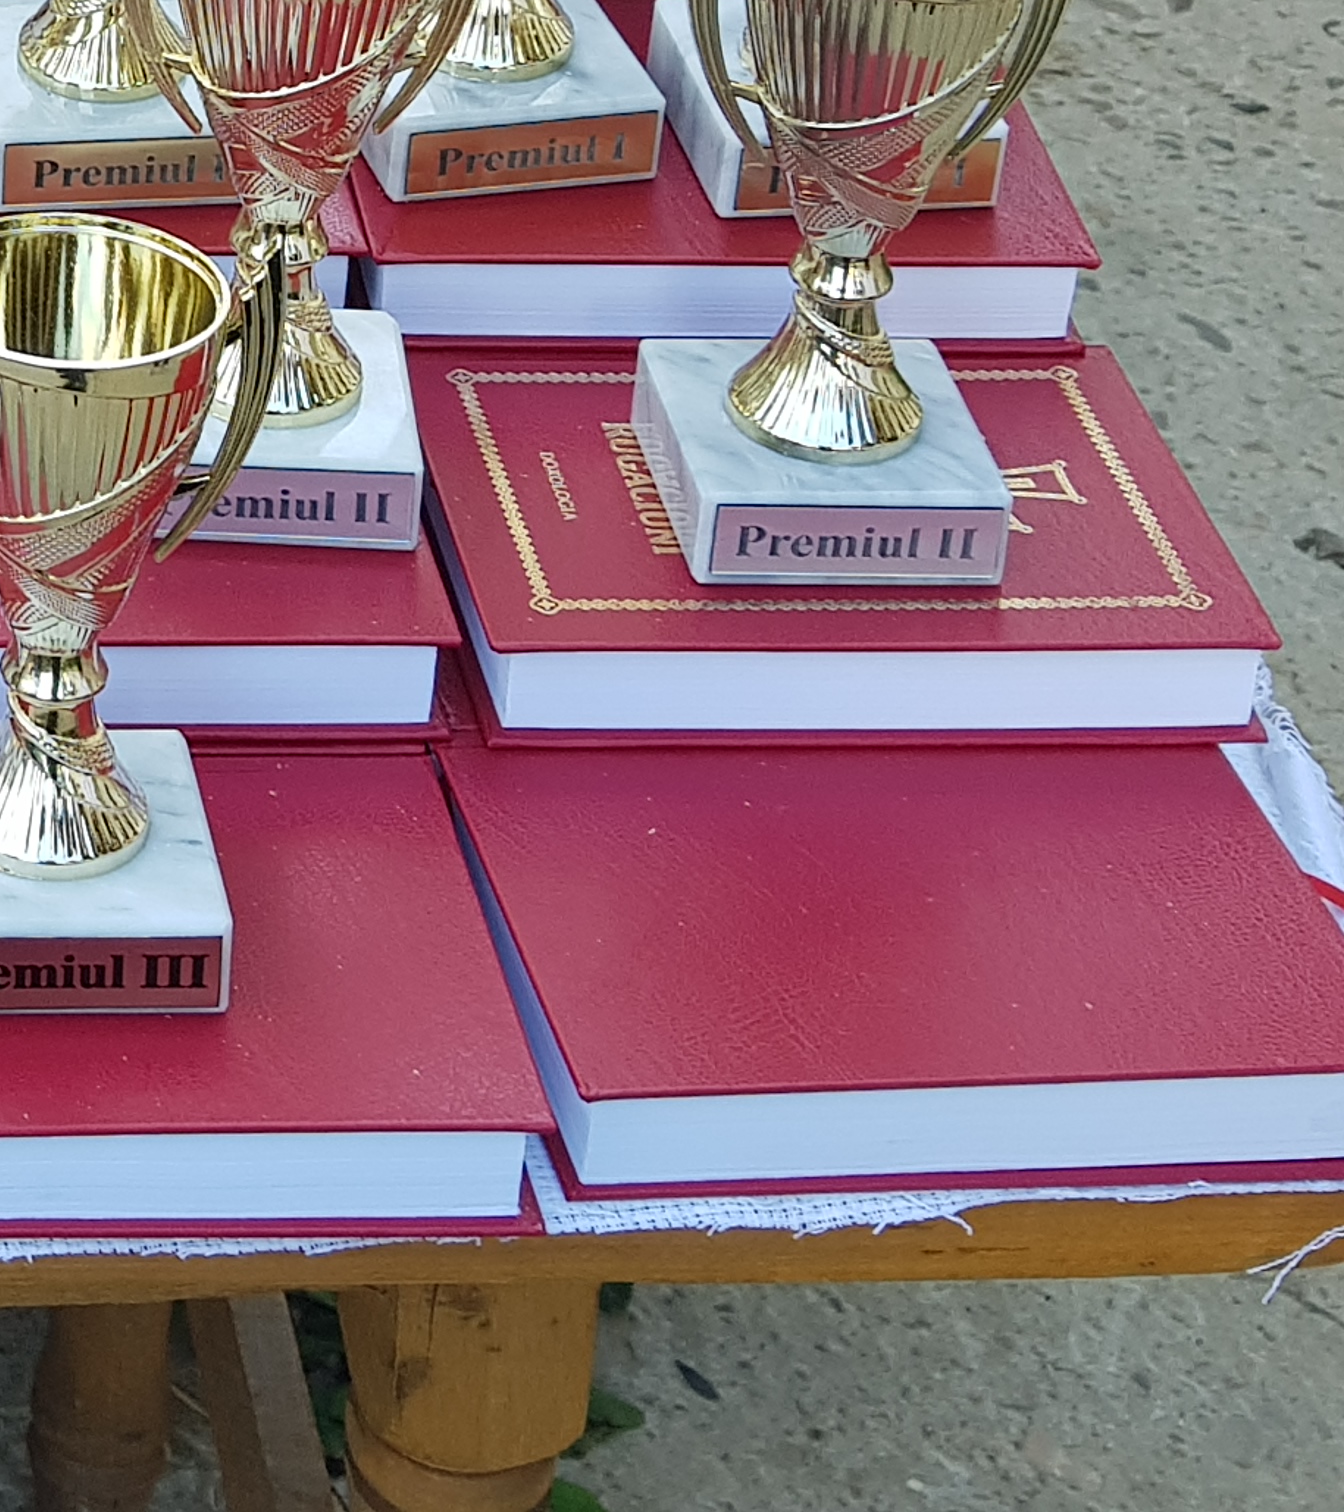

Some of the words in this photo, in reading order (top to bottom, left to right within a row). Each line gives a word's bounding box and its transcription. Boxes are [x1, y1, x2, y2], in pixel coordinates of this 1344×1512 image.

[33, 154, 196, 189] Premiul
[438, 135, 596, 177] Premiul
[612, 132, 625, 161] I
[539, 451, 578, 521] DOXOLOGIA
[212, 489, 335, 523] emiul
[354, 491, 392, 524] II
[735, 524, 921, 559] Premiul
[938, 527, 979, 561] II
[140, 953, 211, 989] III
